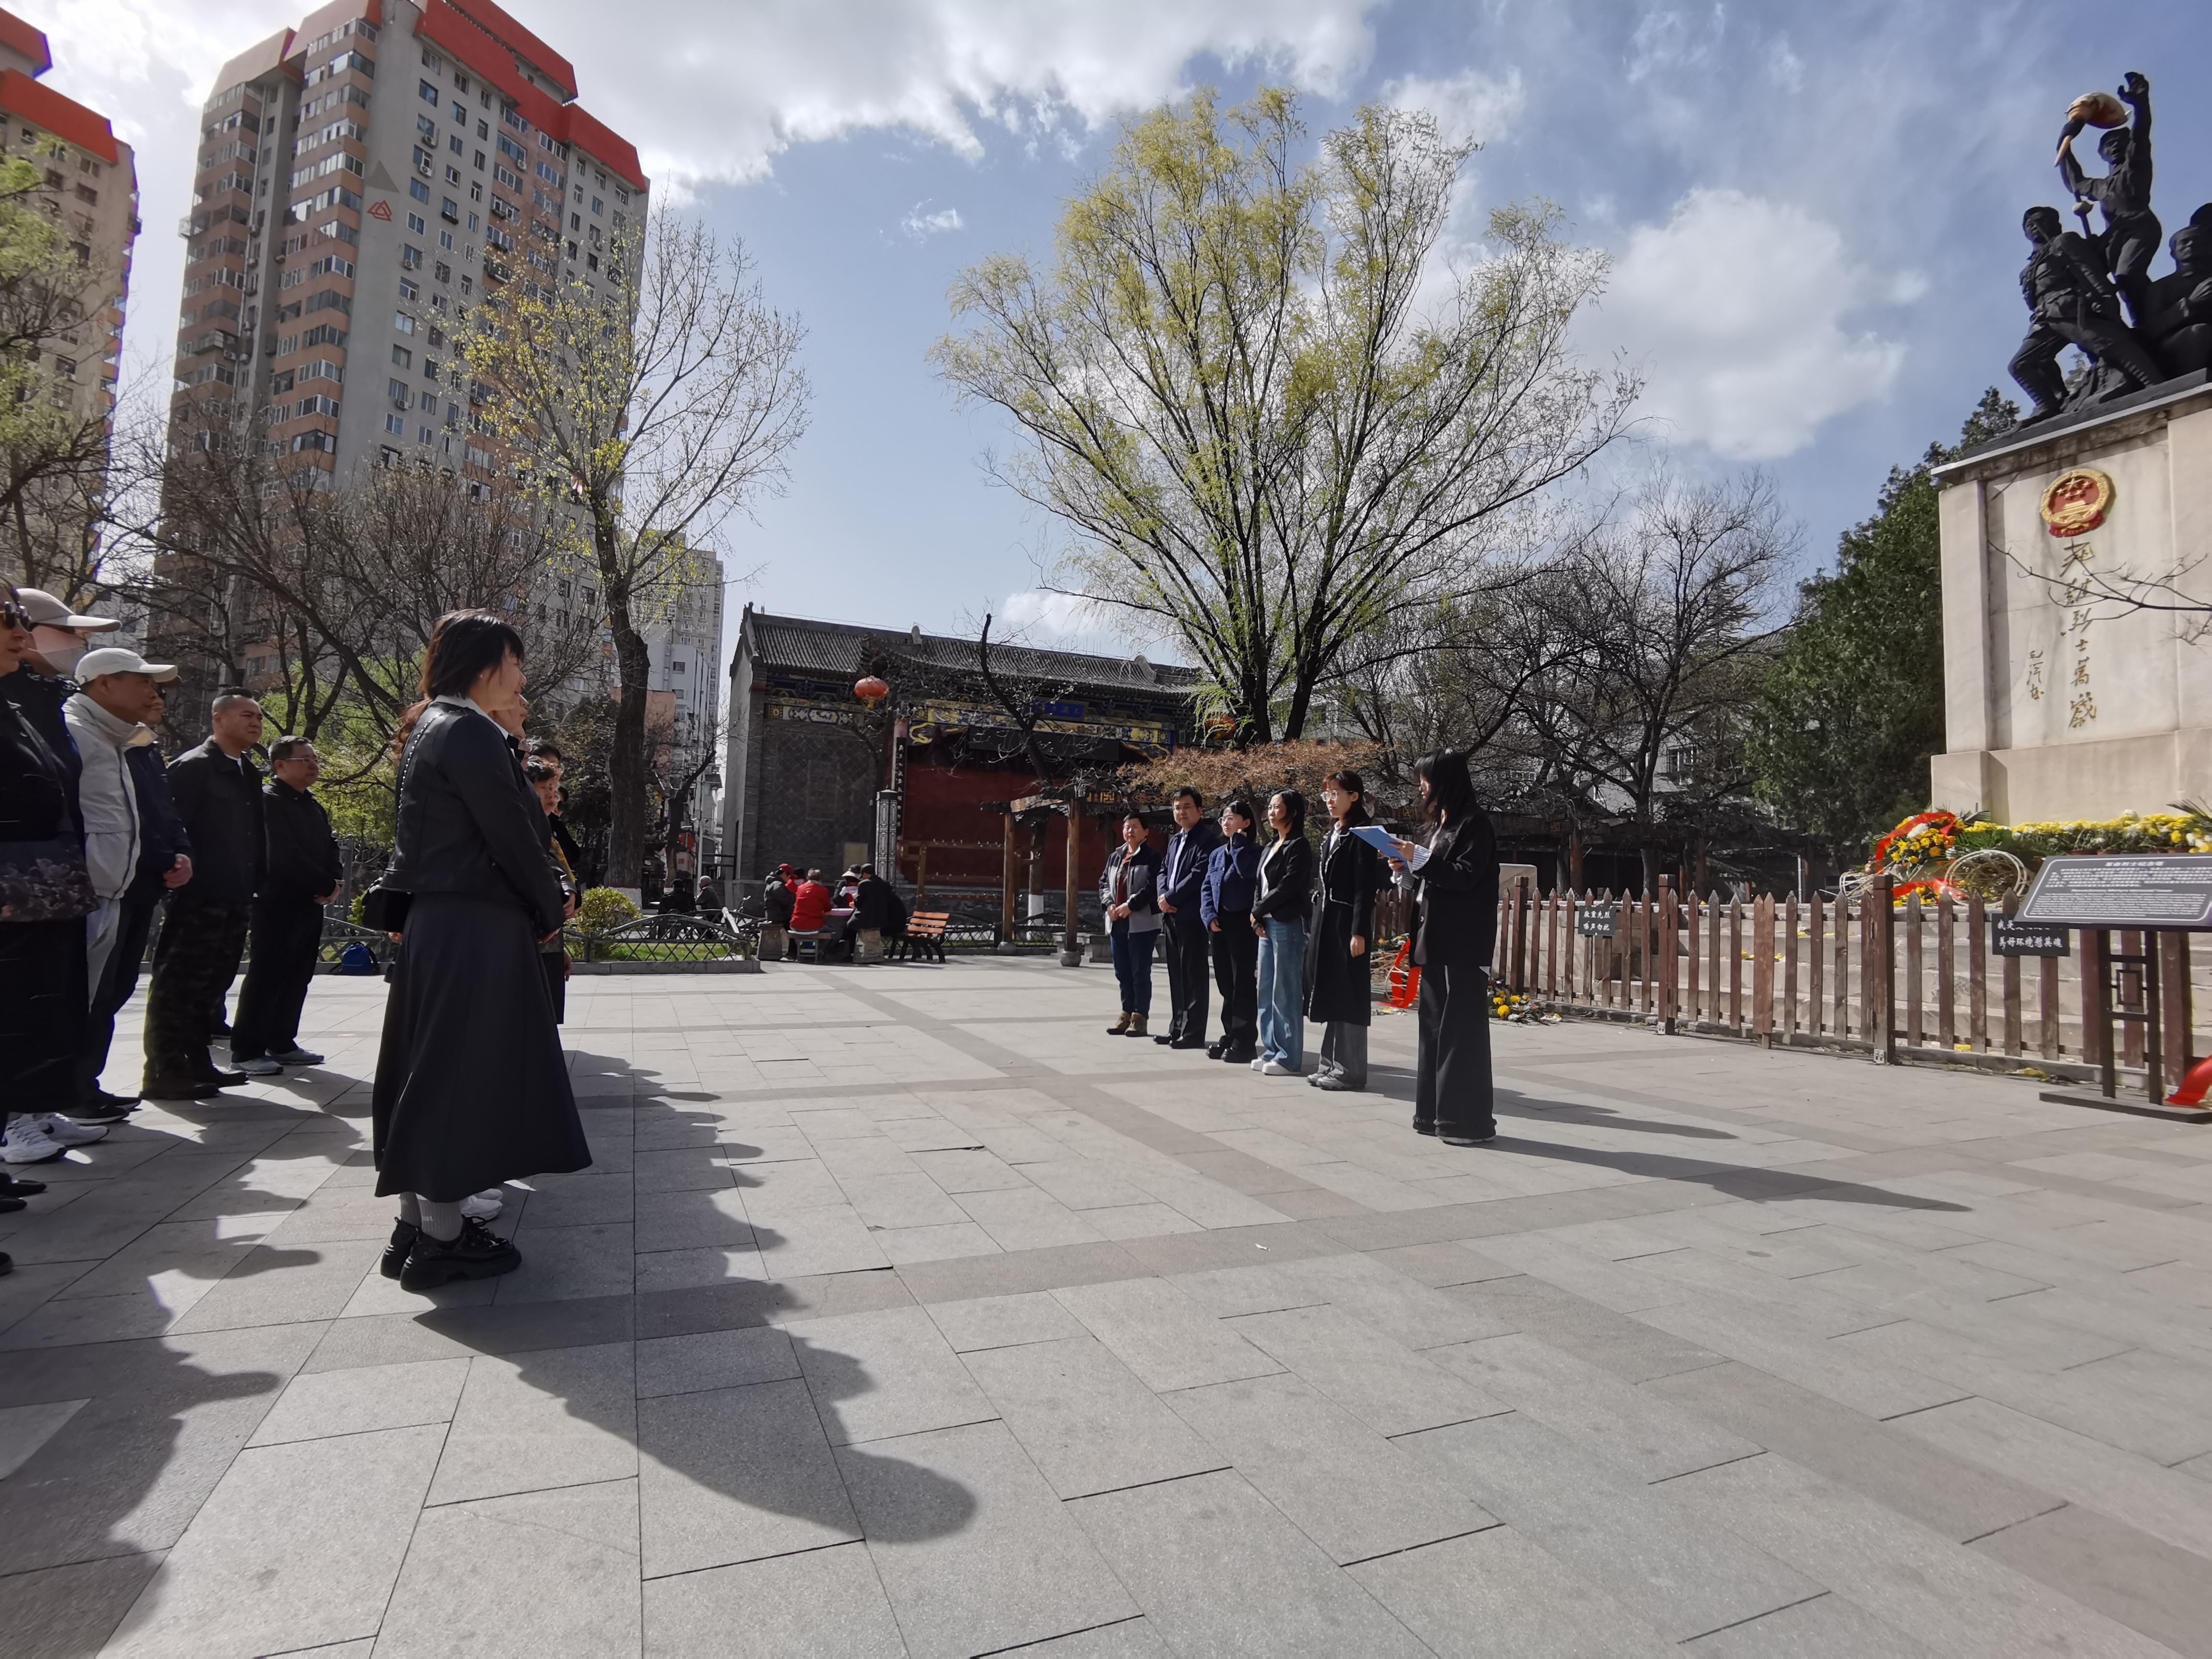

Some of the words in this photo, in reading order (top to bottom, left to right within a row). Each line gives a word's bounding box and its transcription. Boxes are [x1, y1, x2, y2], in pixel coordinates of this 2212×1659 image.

[1583, 910, 1610, 919] 敬重先烈
[1998, 936, 2063, 949] 美好环境慰英魂
